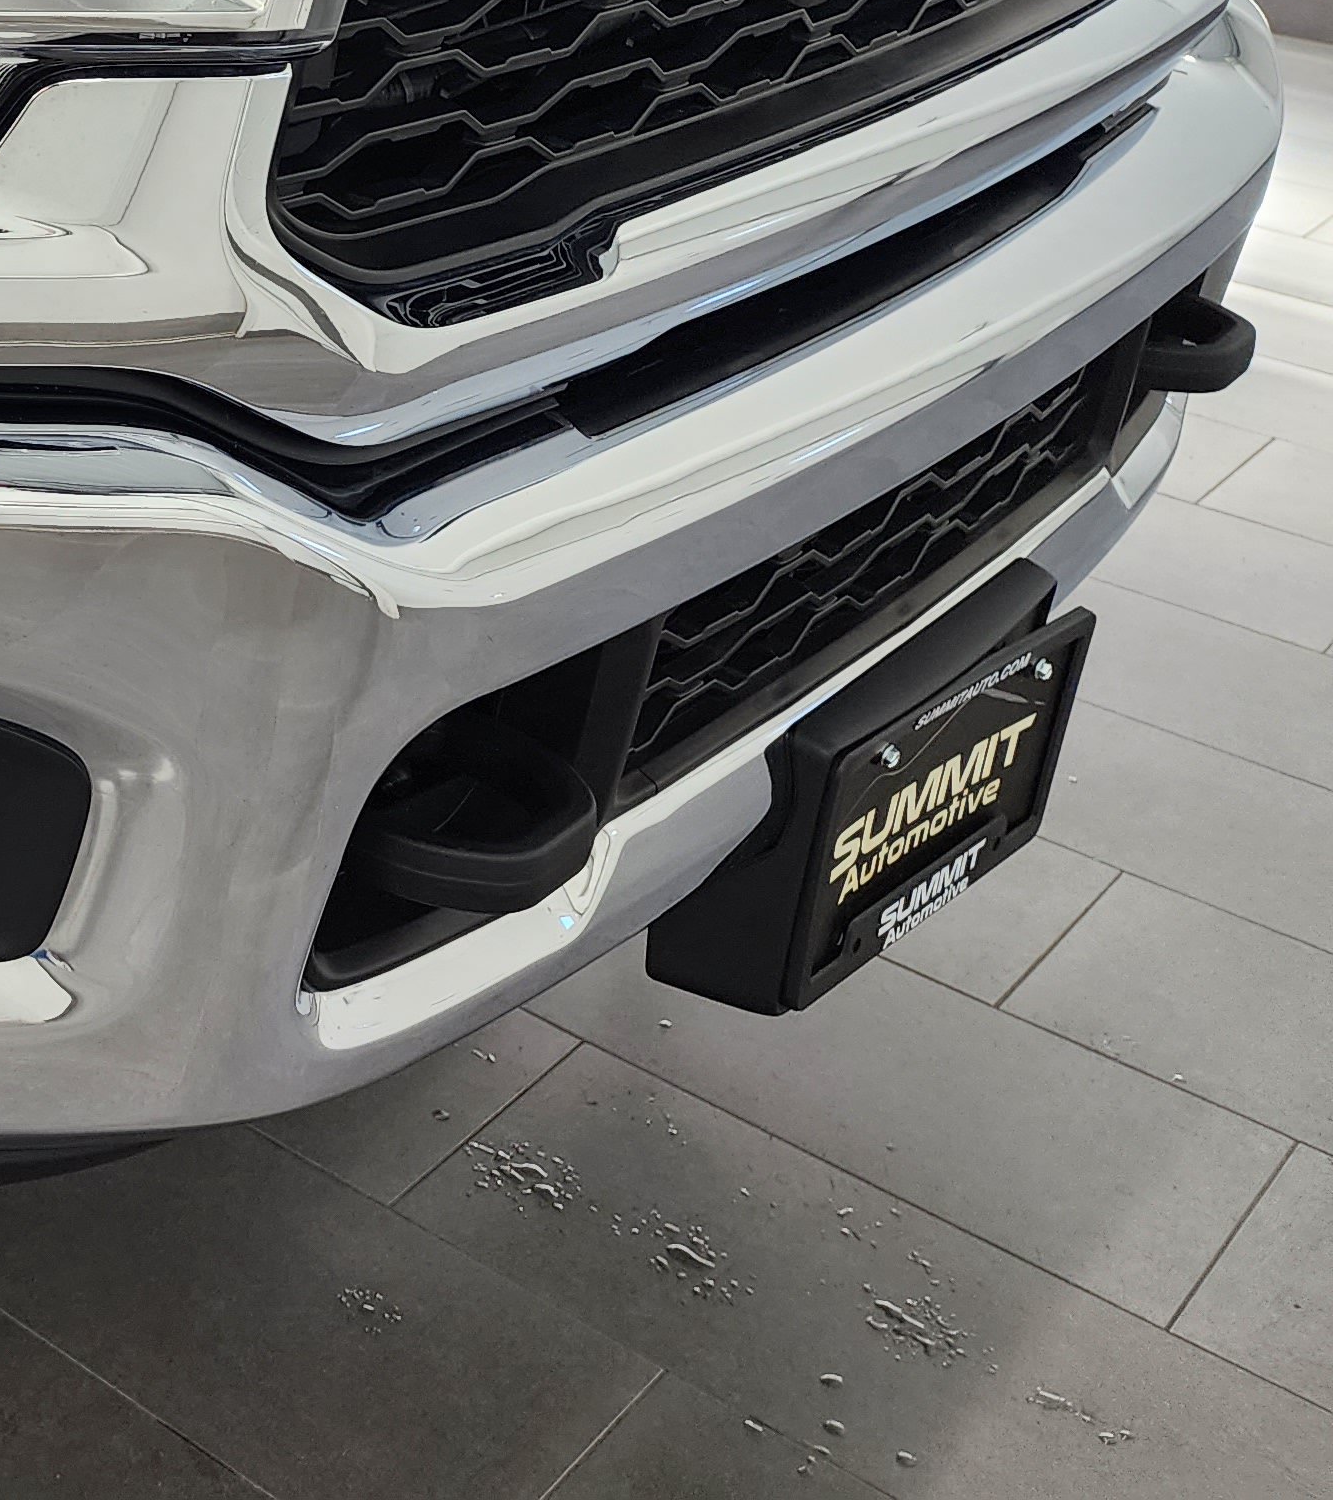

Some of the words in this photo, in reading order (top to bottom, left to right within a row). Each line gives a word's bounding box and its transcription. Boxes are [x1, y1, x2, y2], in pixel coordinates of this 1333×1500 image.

[913, 651, 1032, 731] SUMMITAUTO.COM
[828, 711, 1038, 885] SUMMIT
[837, 777, 1002, 906] Automotive
[877, 837, 988, 928] SUMMIT
[881, 875, 970, 951] Automotive
